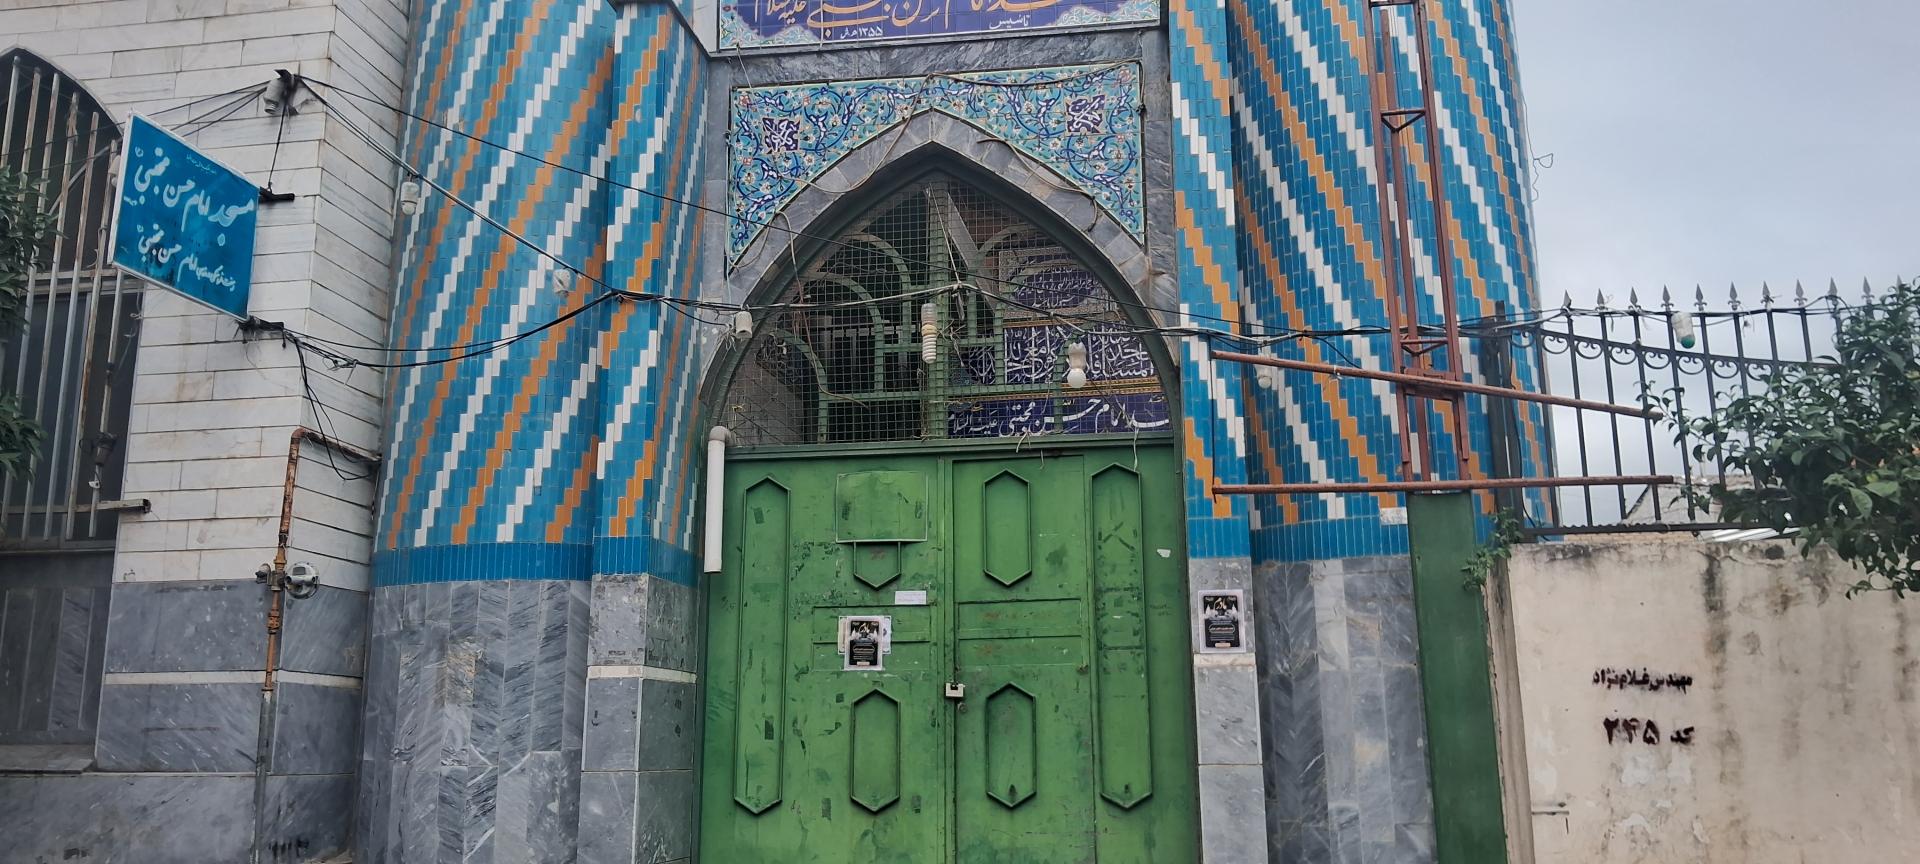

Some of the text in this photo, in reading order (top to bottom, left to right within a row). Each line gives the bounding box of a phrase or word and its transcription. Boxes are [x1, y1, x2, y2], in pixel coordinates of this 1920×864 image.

[133, 147, 171, 205] مجتبی
[162, 178, 196, 208] حسن
[181, 189, 211, 232] امام
[207, 198, 255, 247] مسجد
[137, 223, 165, 263] مجتبی
[157, 244, 183, 264] حسن
[176, 253, 198, 283] امام
[999, 400, 1037, 437] مجتبی
[1649, 672, 1693, 695] مهندس
[1602, 717, 1695, 746] کد ۲۴۵
